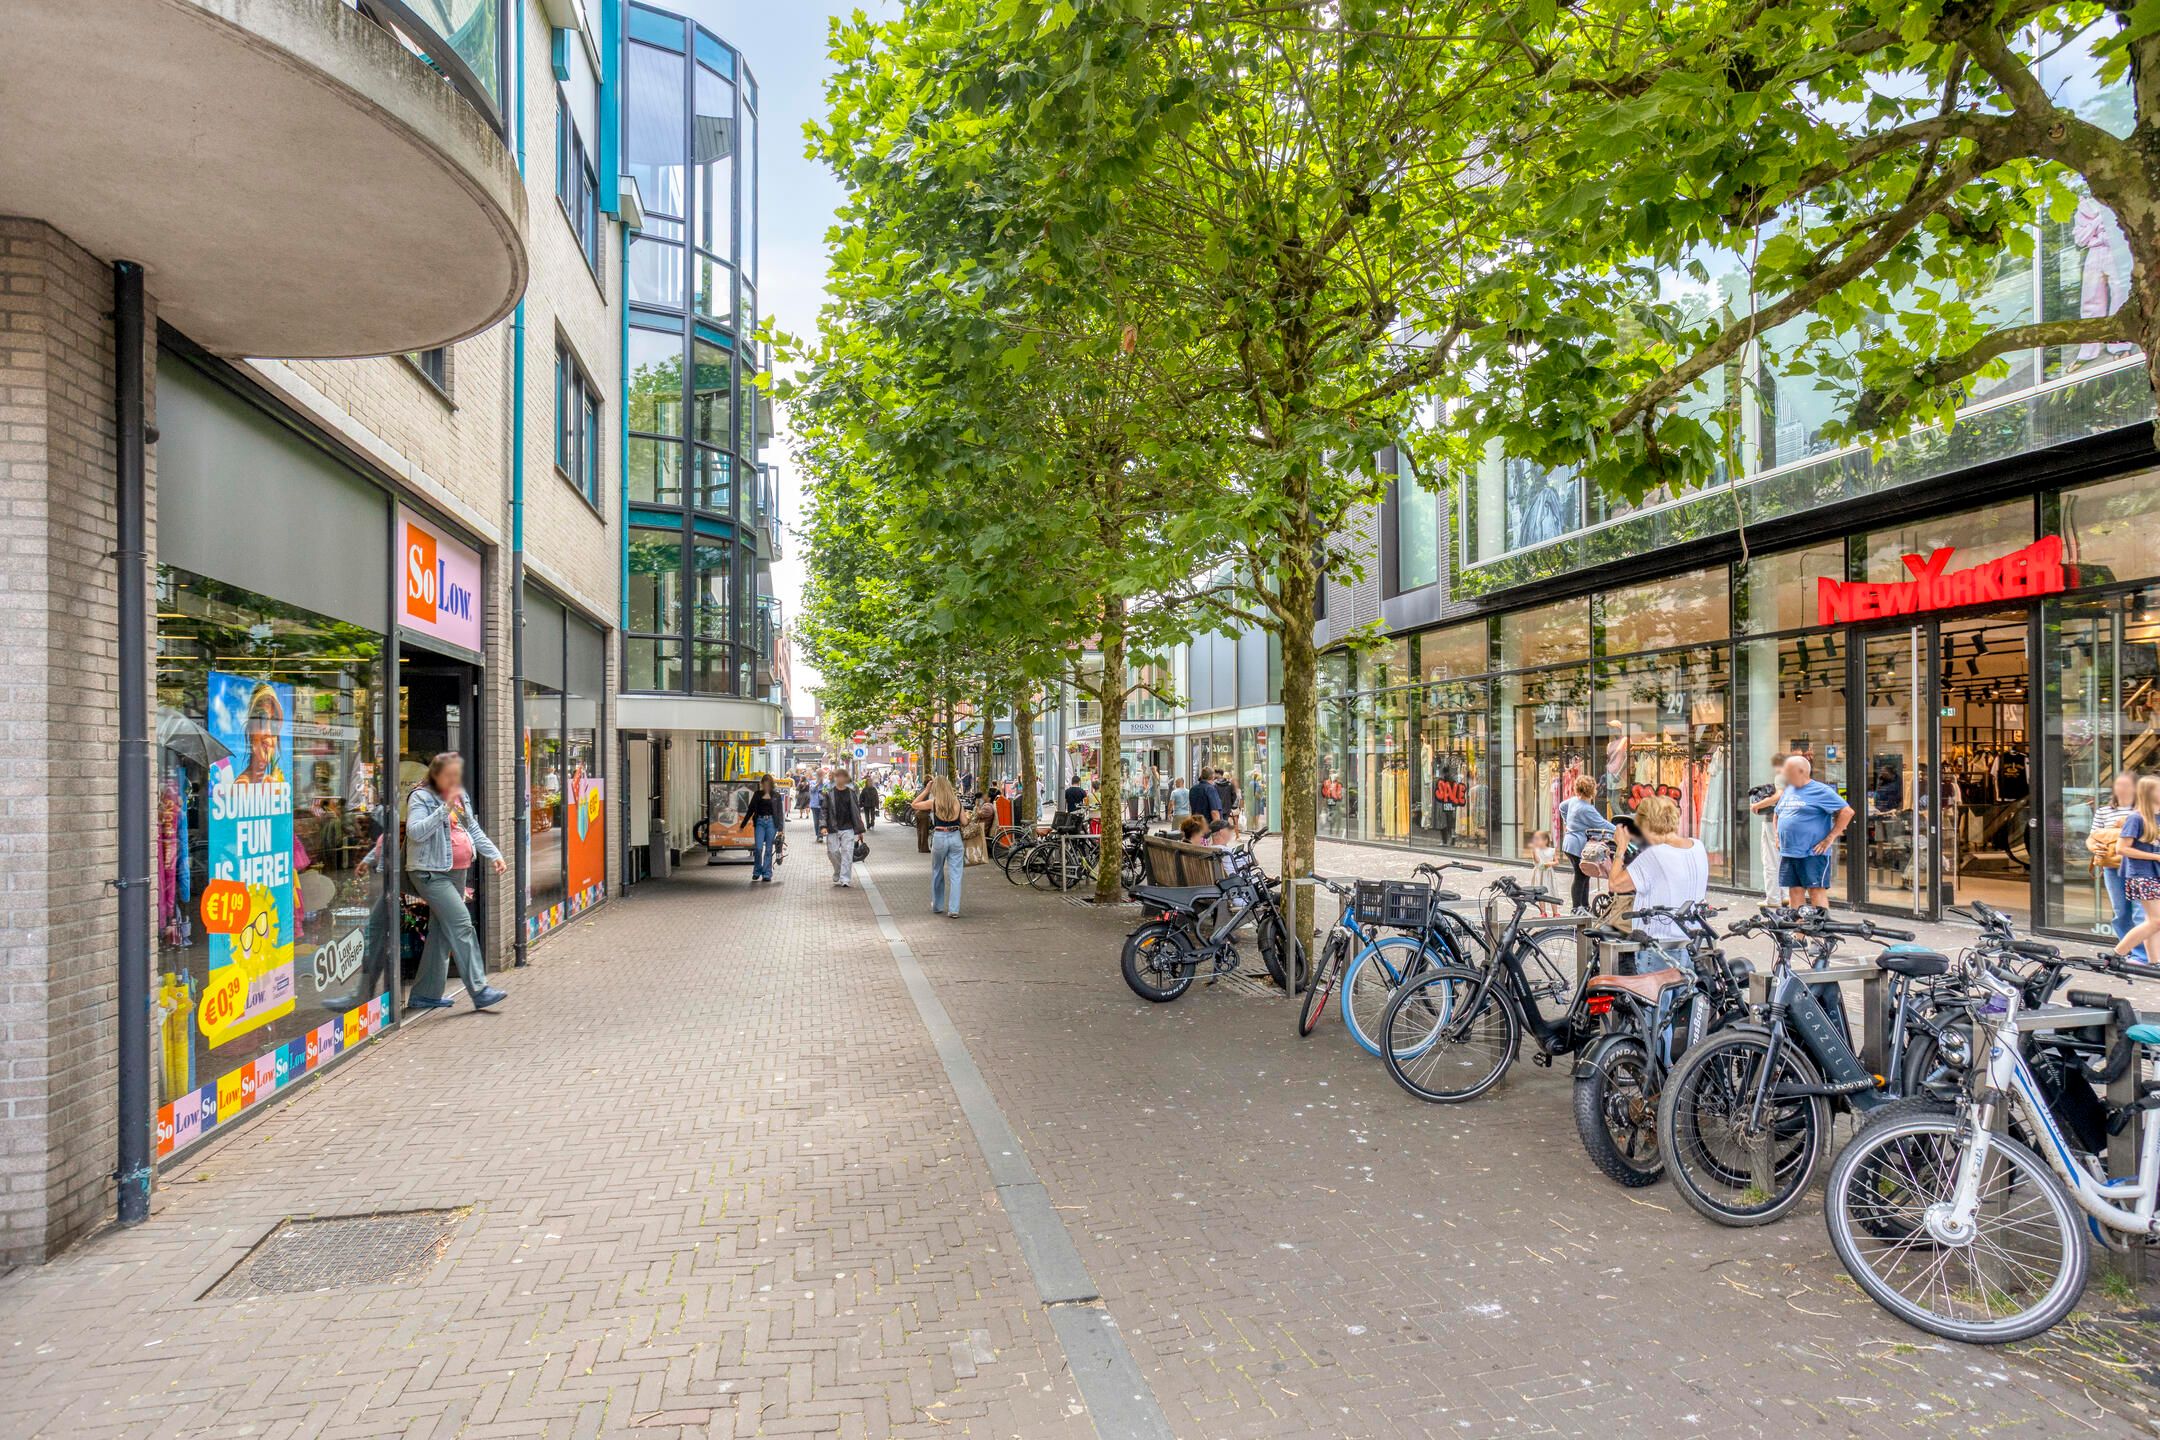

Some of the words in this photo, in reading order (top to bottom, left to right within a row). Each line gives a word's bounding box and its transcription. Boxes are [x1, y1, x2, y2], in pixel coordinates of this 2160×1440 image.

[212, 781, 292, 820] SUMMER
[1435, 779, 1467, 806] SALE
[236, 818, 272, 857] FUN
[240, 851, 290, 890] HERE!
[2090, 922, 2112, 935] JO
[316, 944, 337, 987] SO
[1603, 1048, 1638, 1070] KENDA
[1804, 1011, 1851, 1078] GAZELL
